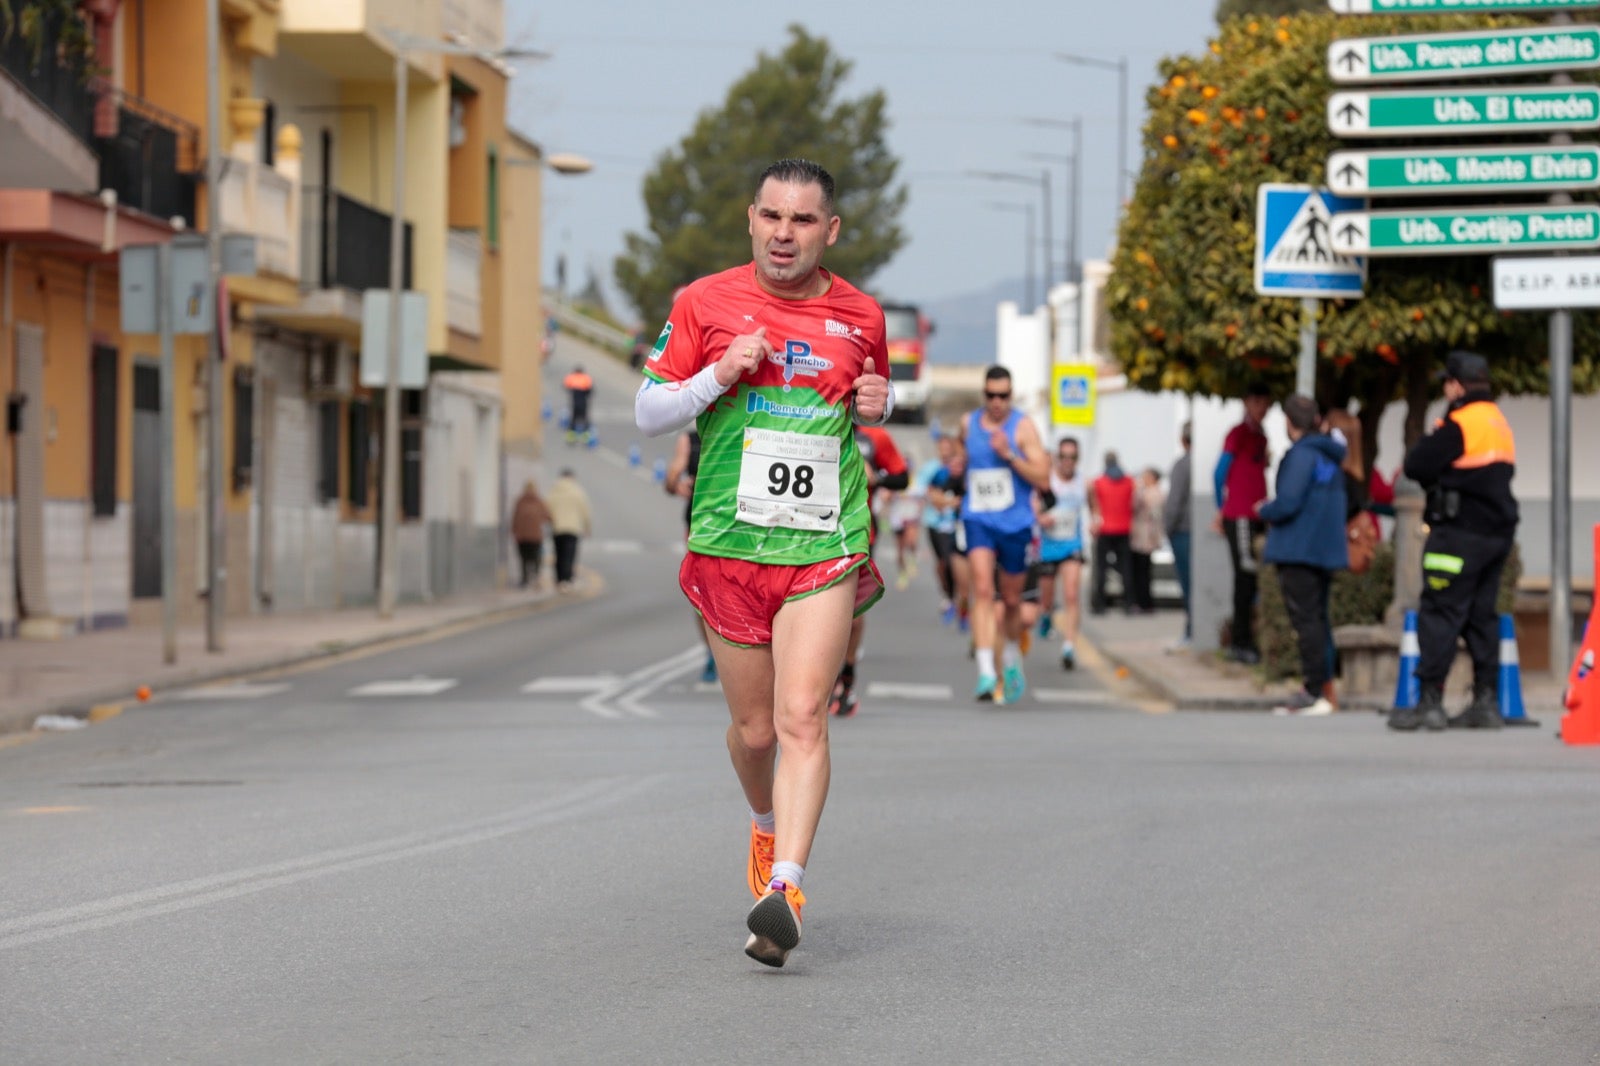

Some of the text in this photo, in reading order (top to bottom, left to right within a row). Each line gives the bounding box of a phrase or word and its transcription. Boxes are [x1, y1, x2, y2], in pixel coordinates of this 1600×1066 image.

[1372, 36, 1594, 69] Urb. Parque del Cubillas
[1434, 93, 1593, 121] Urb. El torreón
[1404, 154, 1593, 183] Urb. Monte Elvira
[1399, 213, 1594, 245] Urb. Cortijo Pretel
[785, 339, 826, 368] Poncho
[768, 462, 814, 499] 98
